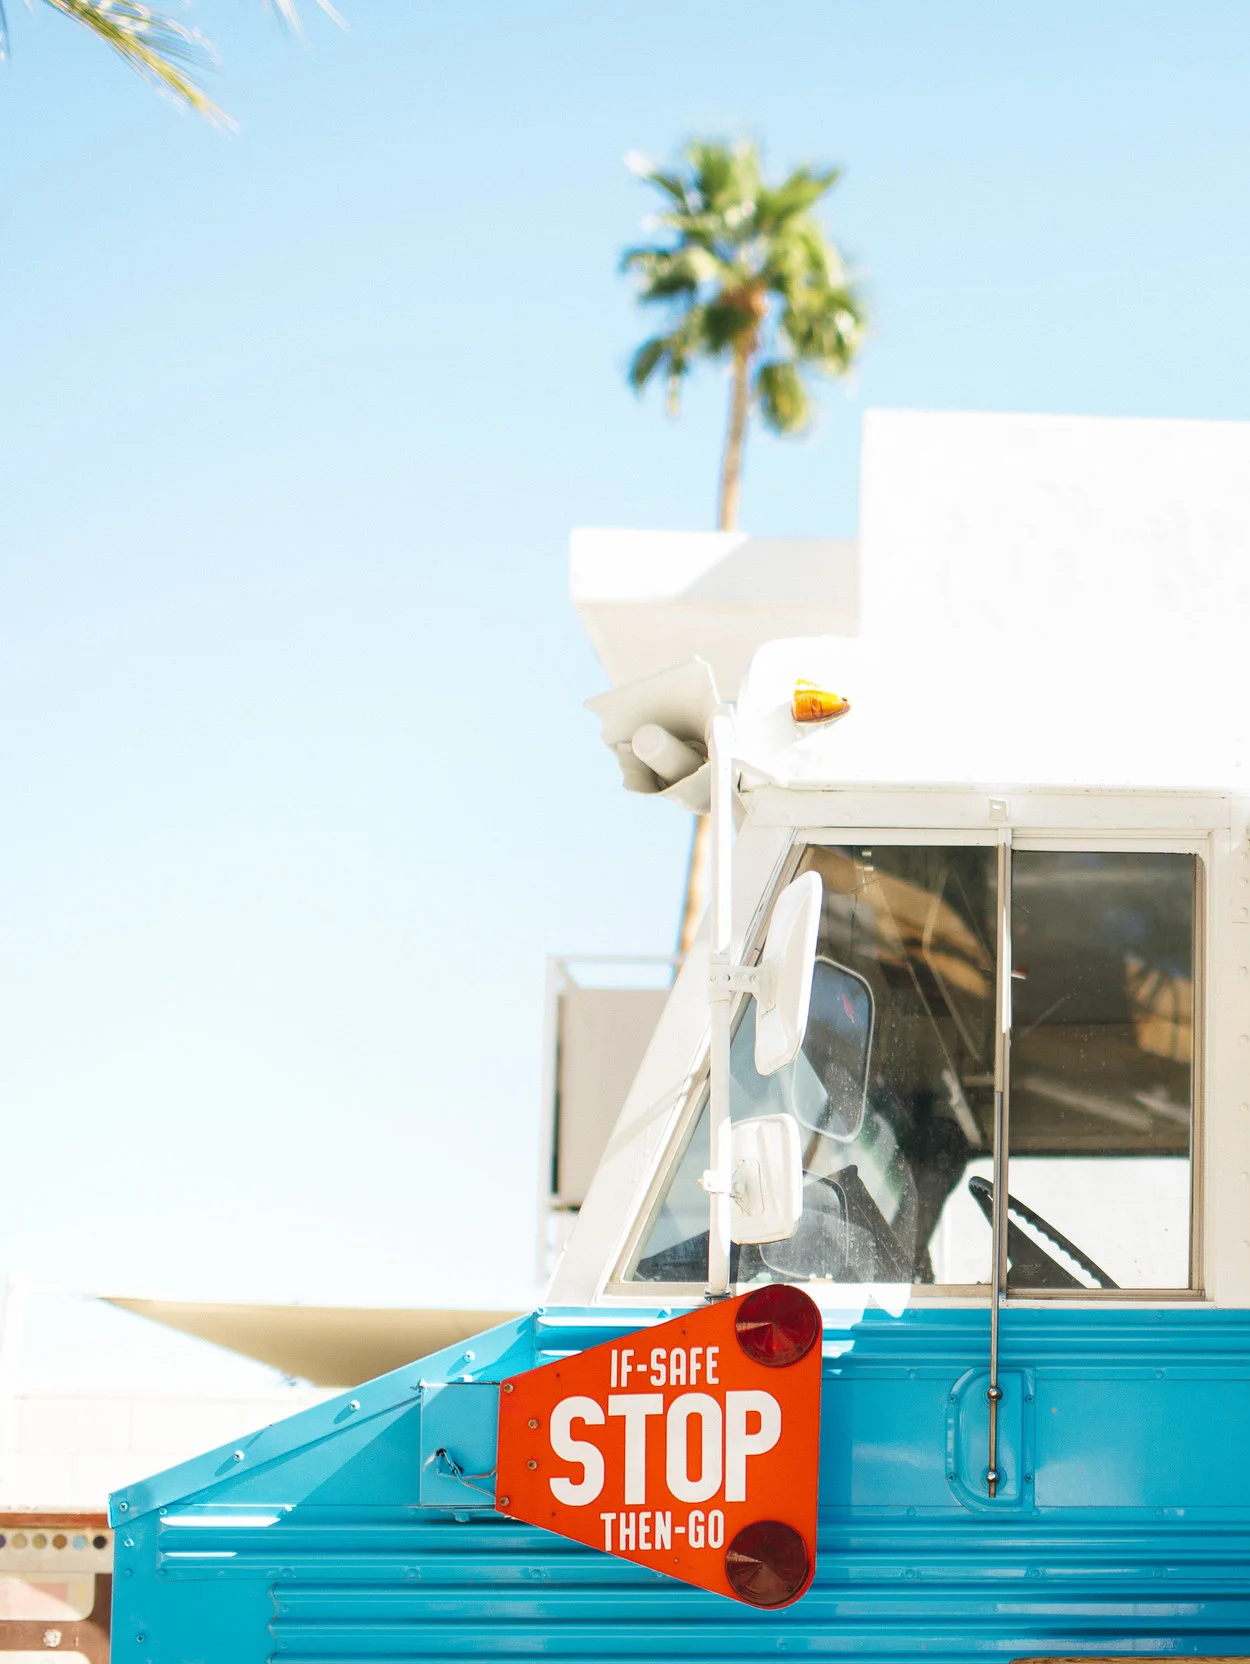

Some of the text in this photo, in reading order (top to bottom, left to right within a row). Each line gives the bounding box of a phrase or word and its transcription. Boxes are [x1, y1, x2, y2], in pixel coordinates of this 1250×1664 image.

[610, 1346, 720, 1388] IF-SAFE
[549, 1390, 782, 1506] STOP
[600, 1509, 725, 1551] THEN-GO
